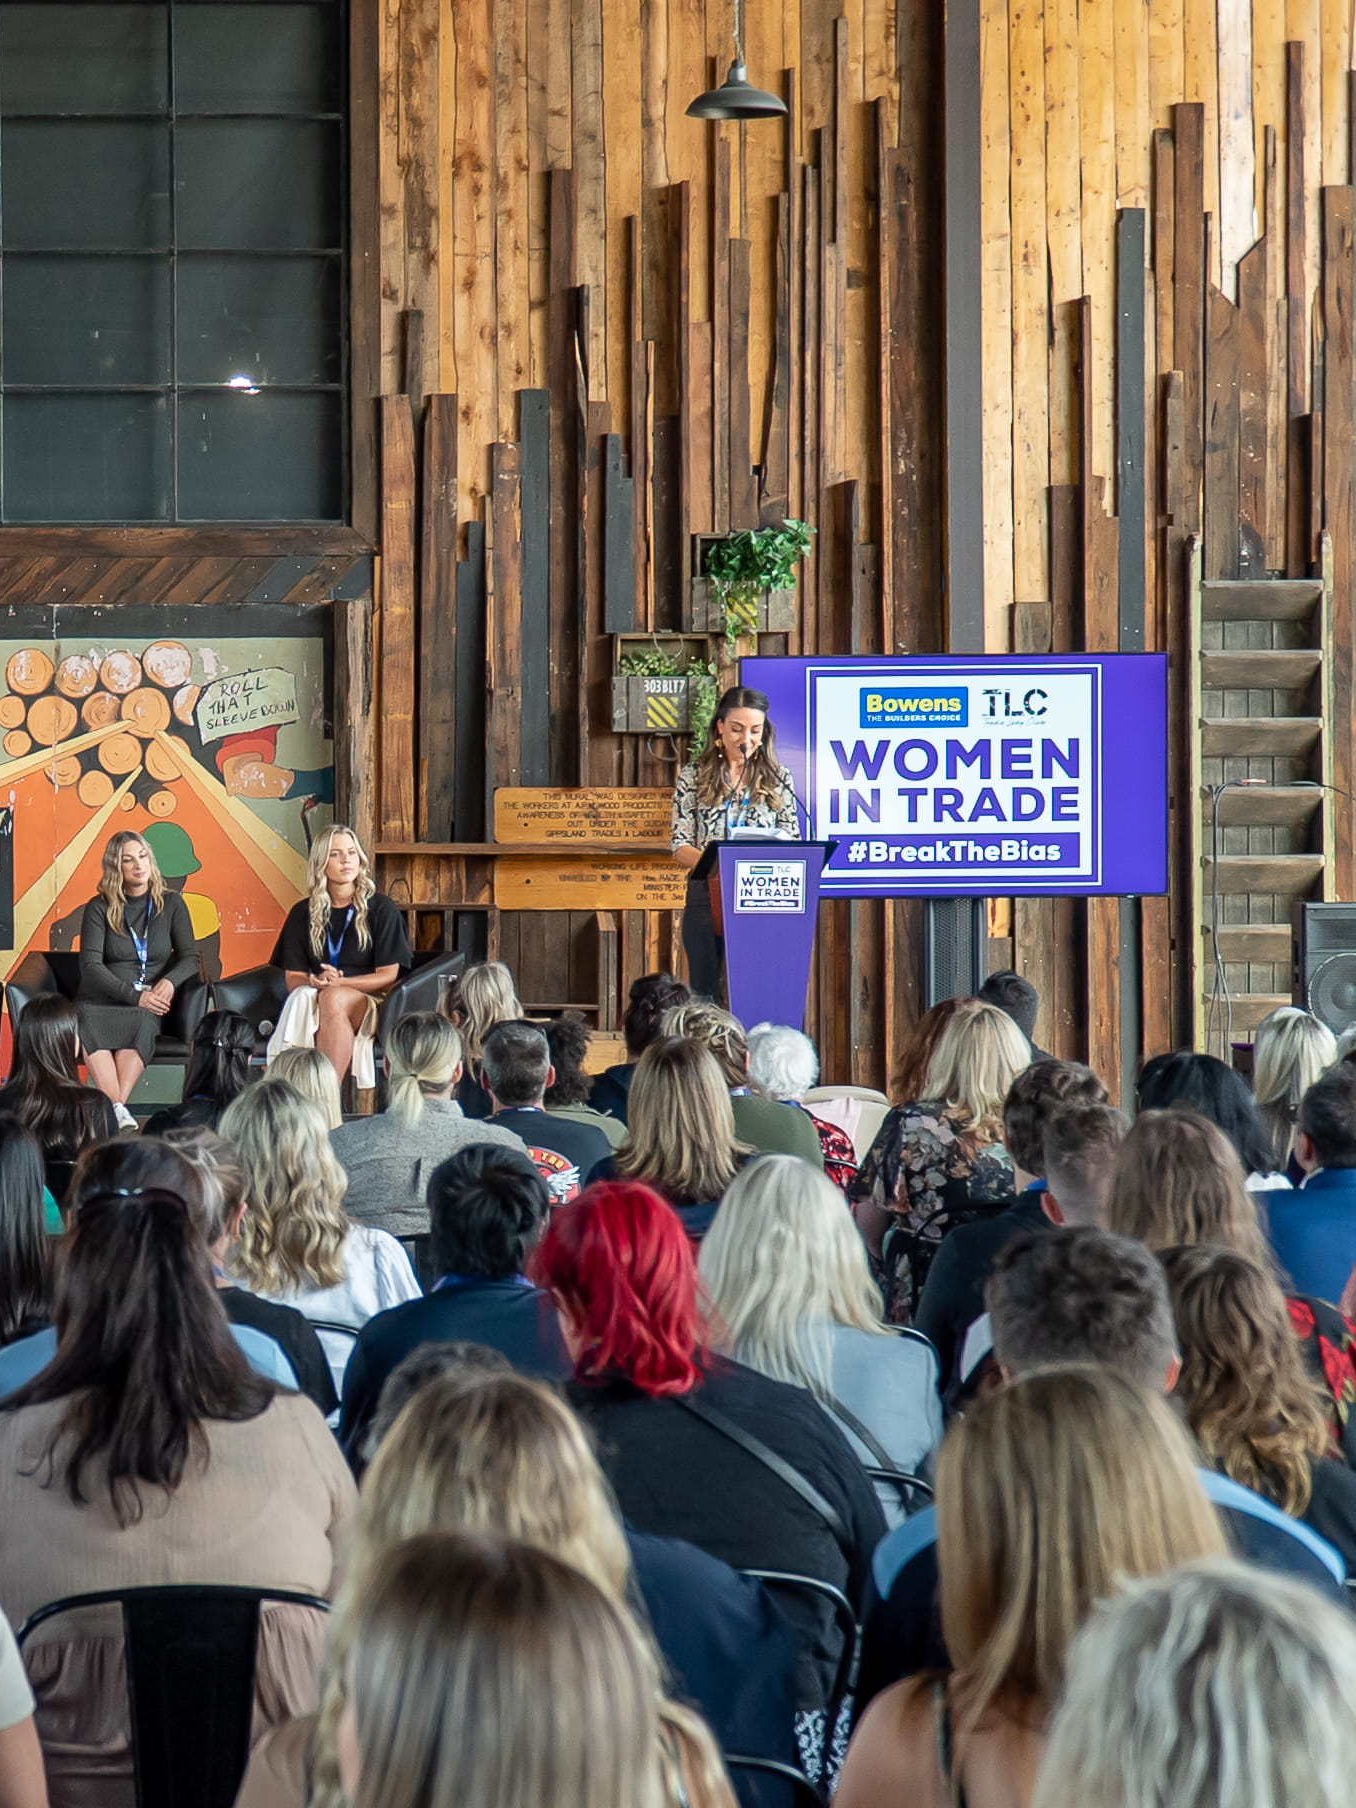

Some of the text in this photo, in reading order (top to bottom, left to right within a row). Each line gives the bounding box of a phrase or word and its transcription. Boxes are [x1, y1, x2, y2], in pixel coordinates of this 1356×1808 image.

[221, 677, 268, 696] ROLL
[209, 692, 252, 714] THAT
[866, 694, 962, 712] Bowens
[982, 689, 1048, 716] TLC
[206, 708, 258, 729] SLEEVE
[829, 737, 1080, 781] WOMEN
[830, 786, 1080, 823] IN TRADE
[847, 840, 1061, 863] #BreakTheBias
[740, 888, 799, 896] IN TRADE
[741, 877, 800, 886] WOMEN
